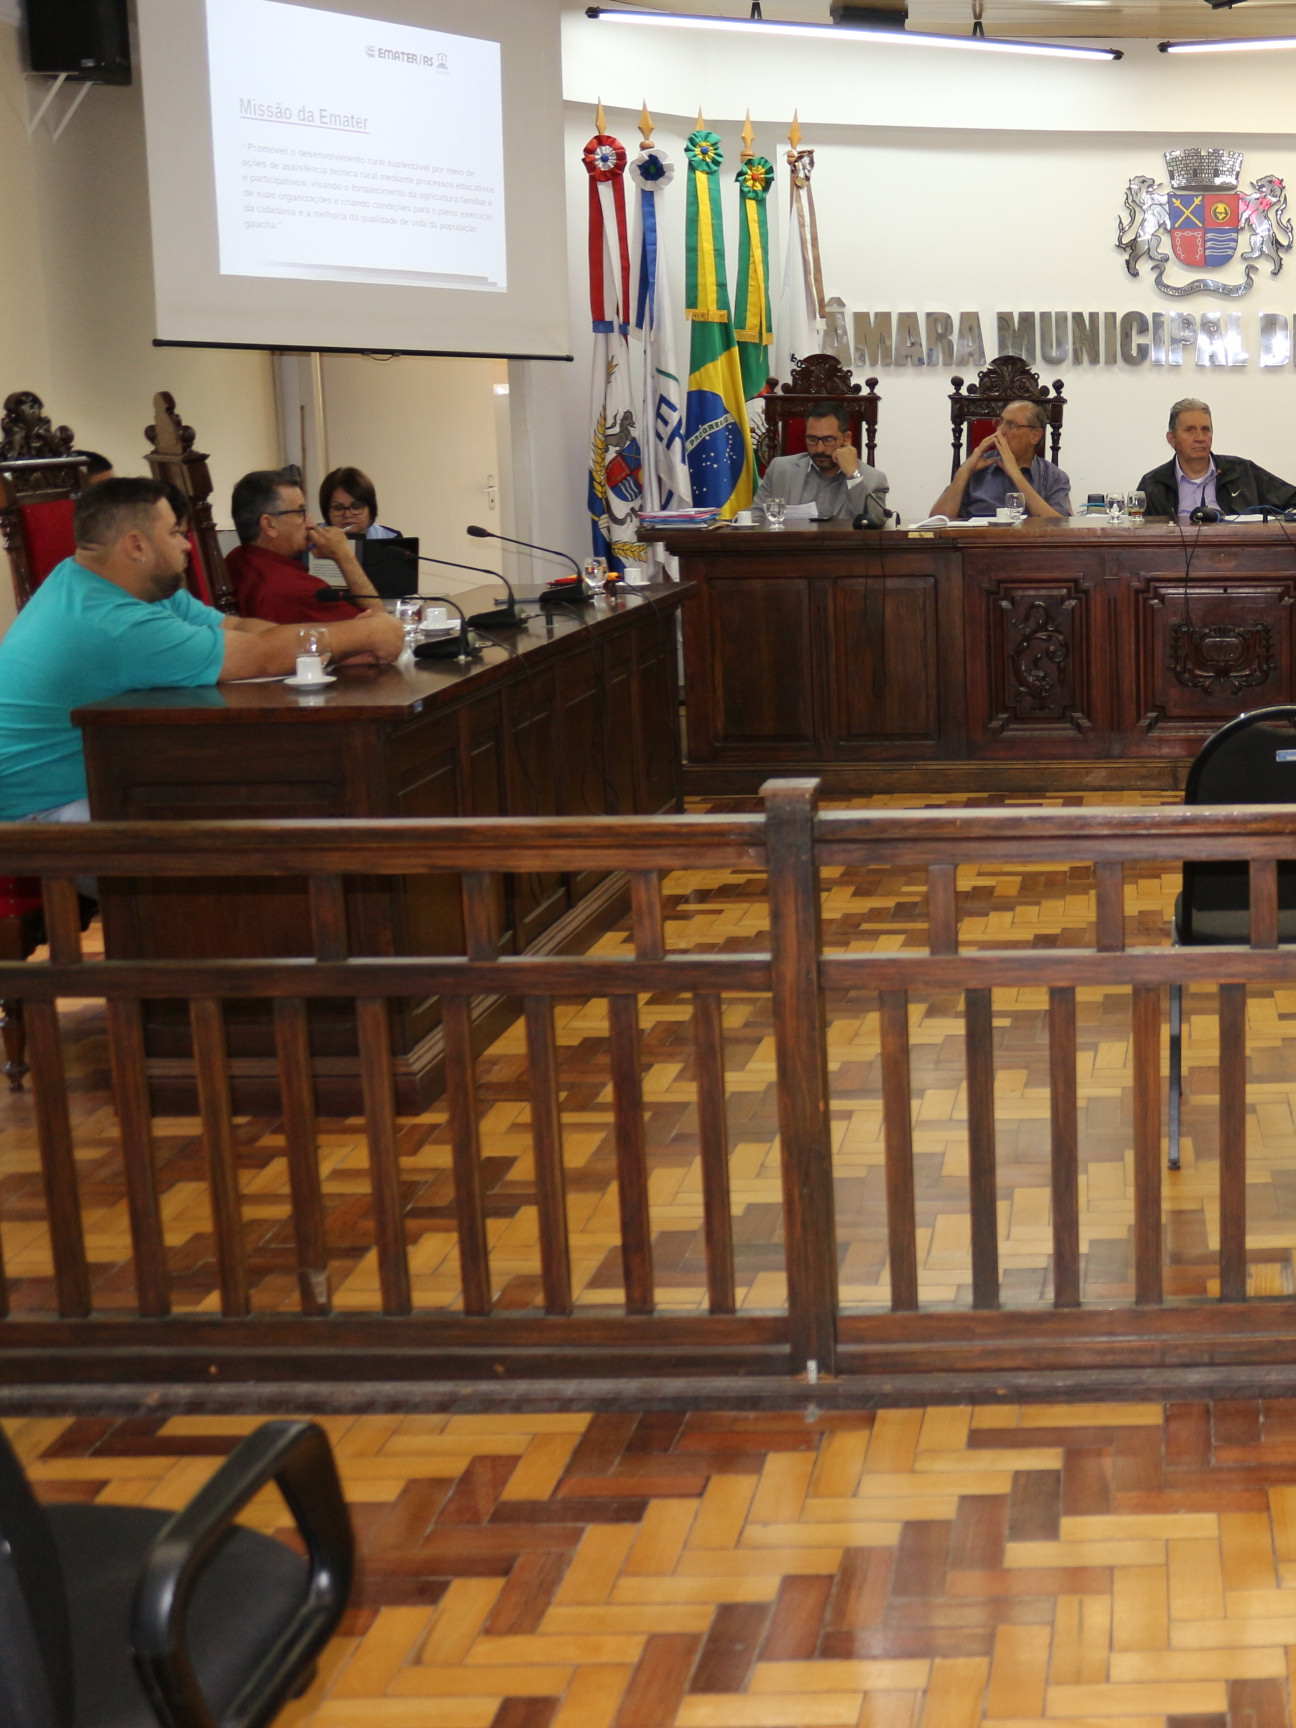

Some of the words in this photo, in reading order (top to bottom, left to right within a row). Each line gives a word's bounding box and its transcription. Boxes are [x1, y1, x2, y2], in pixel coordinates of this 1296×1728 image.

[240, 97, 292, 121] Missão
[297, 105, 315, 124] da
[319, 108, 369, 130] Emater
[817, 297, 987, 367] ÂMARA
[996, 311, 1248, 367] MUNICIPAL
